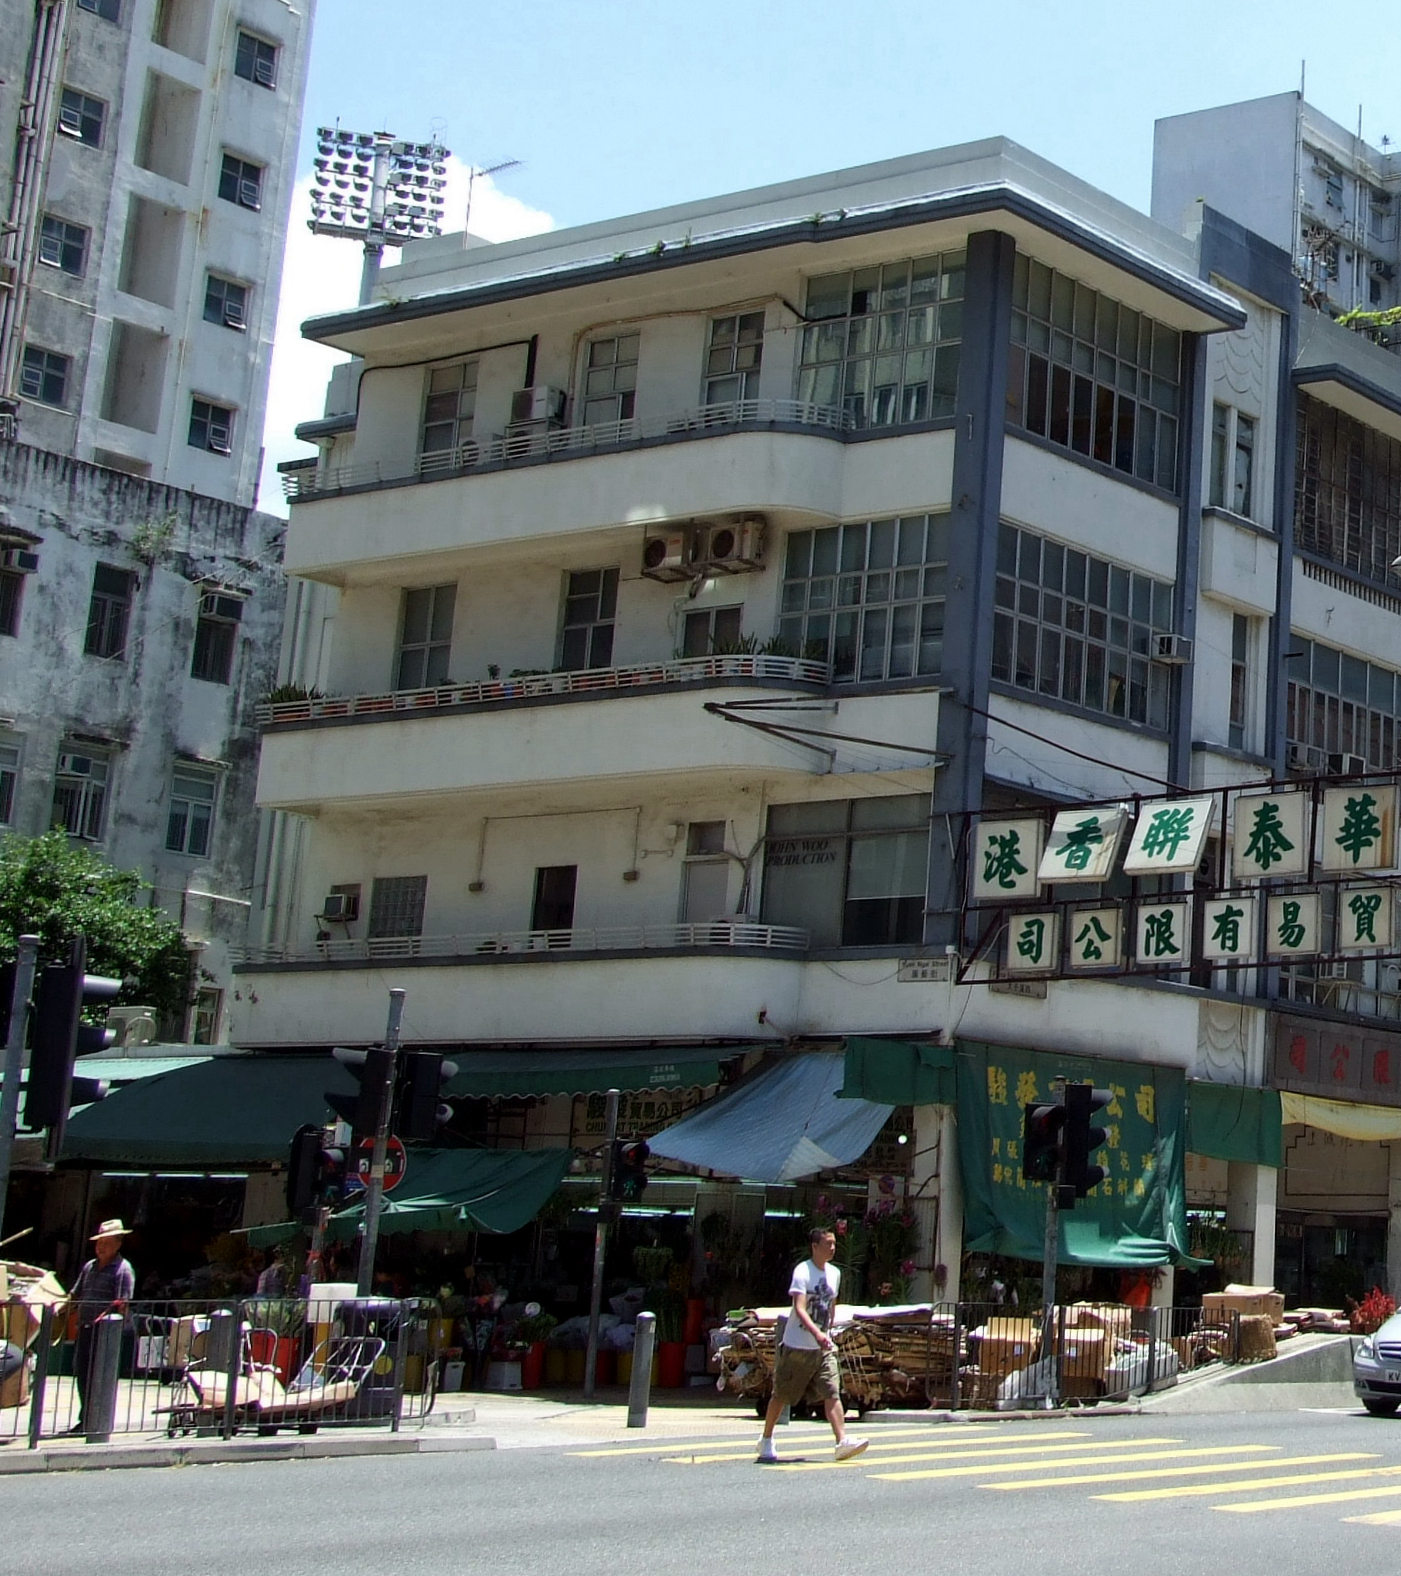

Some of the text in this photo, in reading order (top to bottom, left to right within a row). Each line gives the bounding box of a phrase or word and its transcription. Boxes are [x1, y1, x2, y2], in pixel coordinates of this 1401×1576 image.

[768, 851, 837, 866] PRODUCTION
[1016, 894, 1383, 964] 貿易有限公司
[1388, 1371, 1400, 1382] KV
